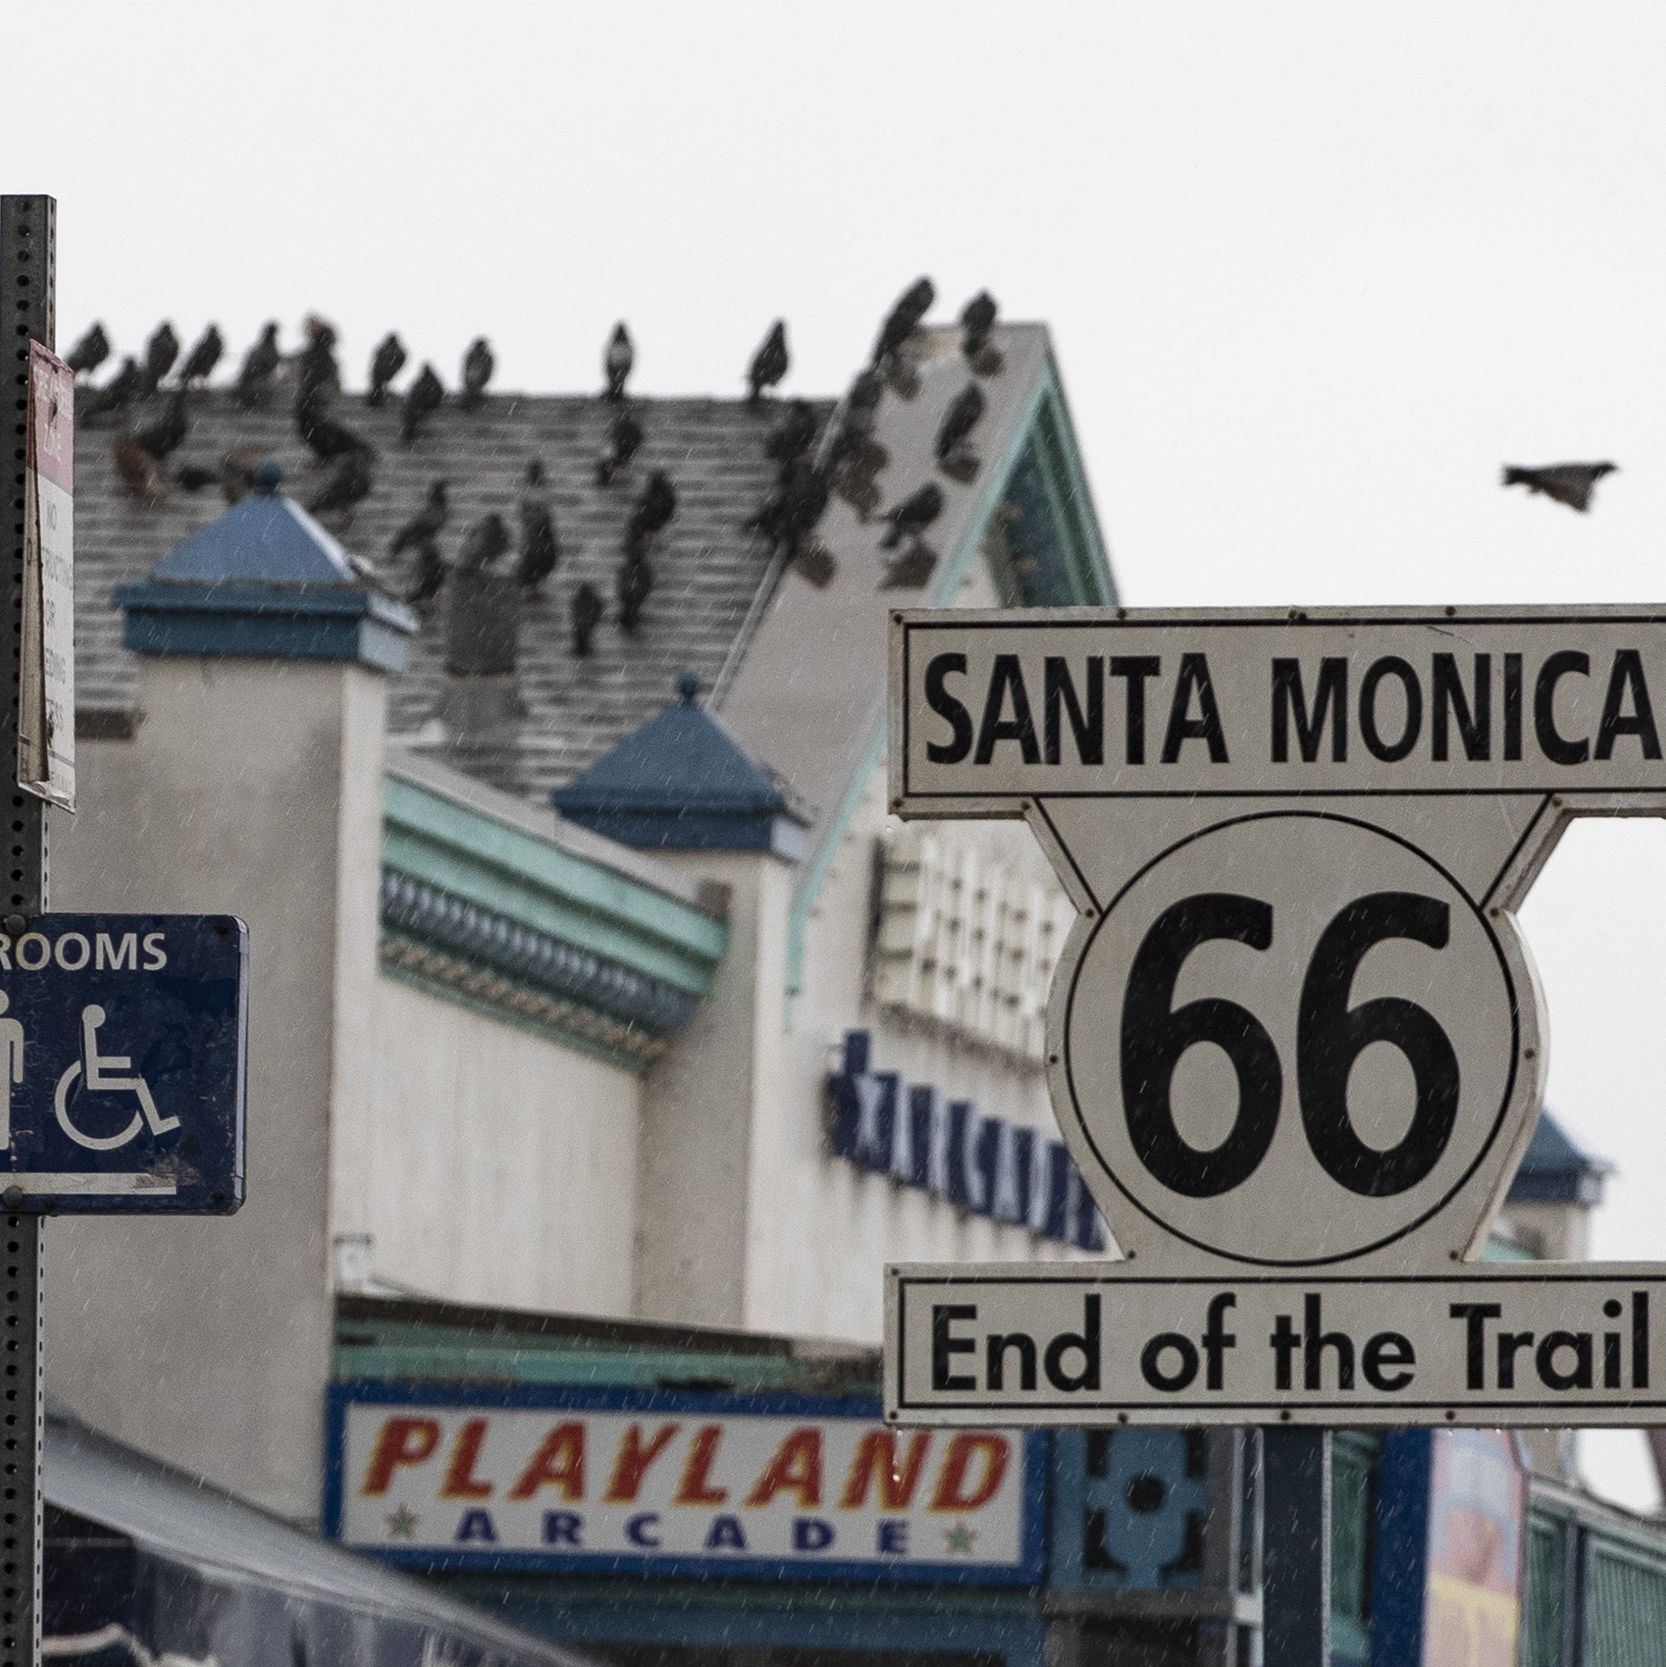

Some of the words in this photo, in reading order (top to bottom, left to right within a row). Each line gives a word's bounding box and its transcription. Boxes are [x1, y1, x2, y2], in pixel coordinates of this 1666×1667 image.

[924, 652, 1230, 767] SANTA
[1271, 648, 1664, 764] MONICA
[1120, 891, 1460, 1199] 66
[932, 1293, 1102, 1392] End
[1140, 1292, 1237, 1392] of
[1271, 1293, 1417, 1391] the
[1449, 1291, 1651, 1391] Trail
[360, 1416, 1012, 1513] PLAYLAND
[455, 1508, 910, 1555] ARCADE
